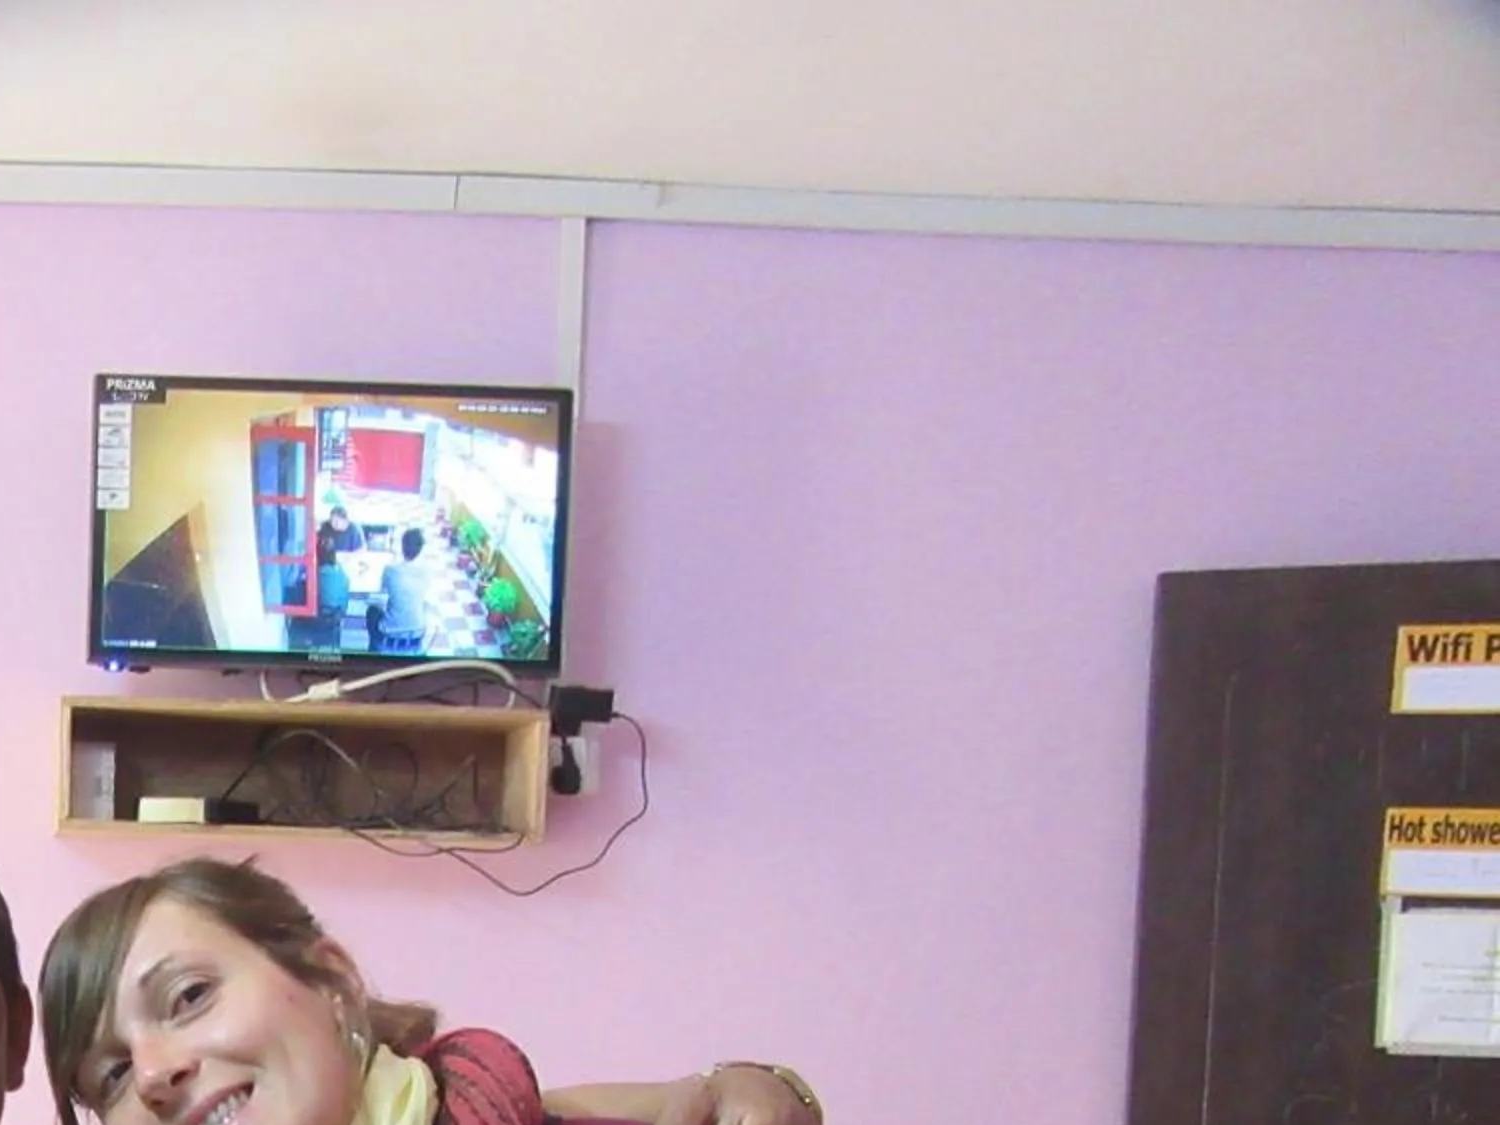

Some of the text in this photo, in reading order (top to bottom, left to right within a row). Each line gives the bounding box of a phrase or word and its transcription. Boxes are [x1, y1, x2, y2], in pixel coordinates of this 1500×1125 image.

[1407, 632, 1474, 662] Wifi
[1389, 813, 1500, 845] Hot showe
